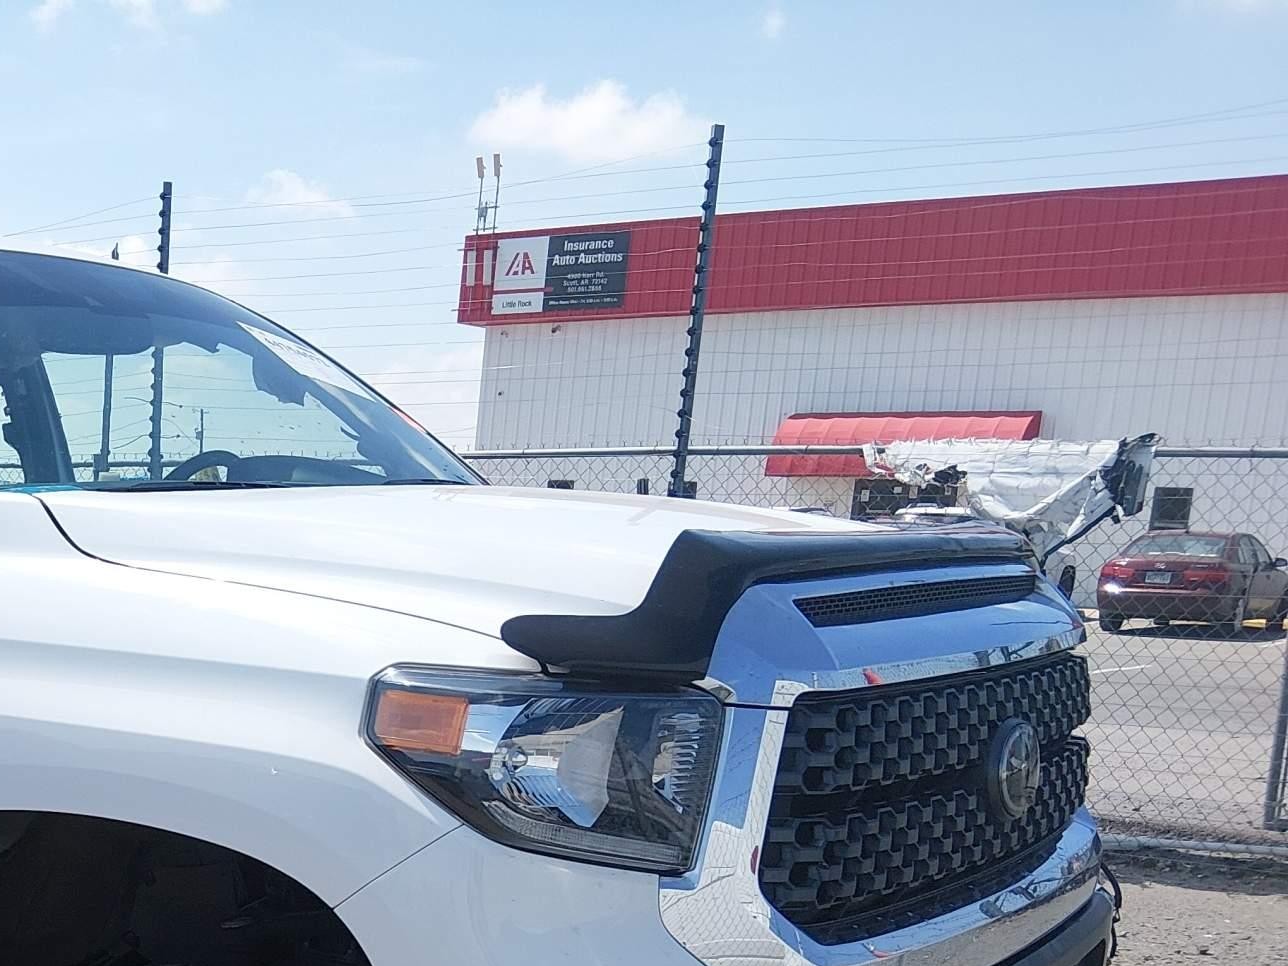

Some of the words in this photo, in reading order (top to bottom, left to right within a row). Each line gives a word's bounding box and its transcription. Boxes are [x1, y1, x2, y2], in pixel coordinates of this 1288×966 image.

[564, 240, 614, 251] Insurance
[552, 254, 575, 266] Auto
[578, 252, 623, 264] Auctions
[502, 300, 516, 308] Little
[518, 300, 532, 308] Rock
